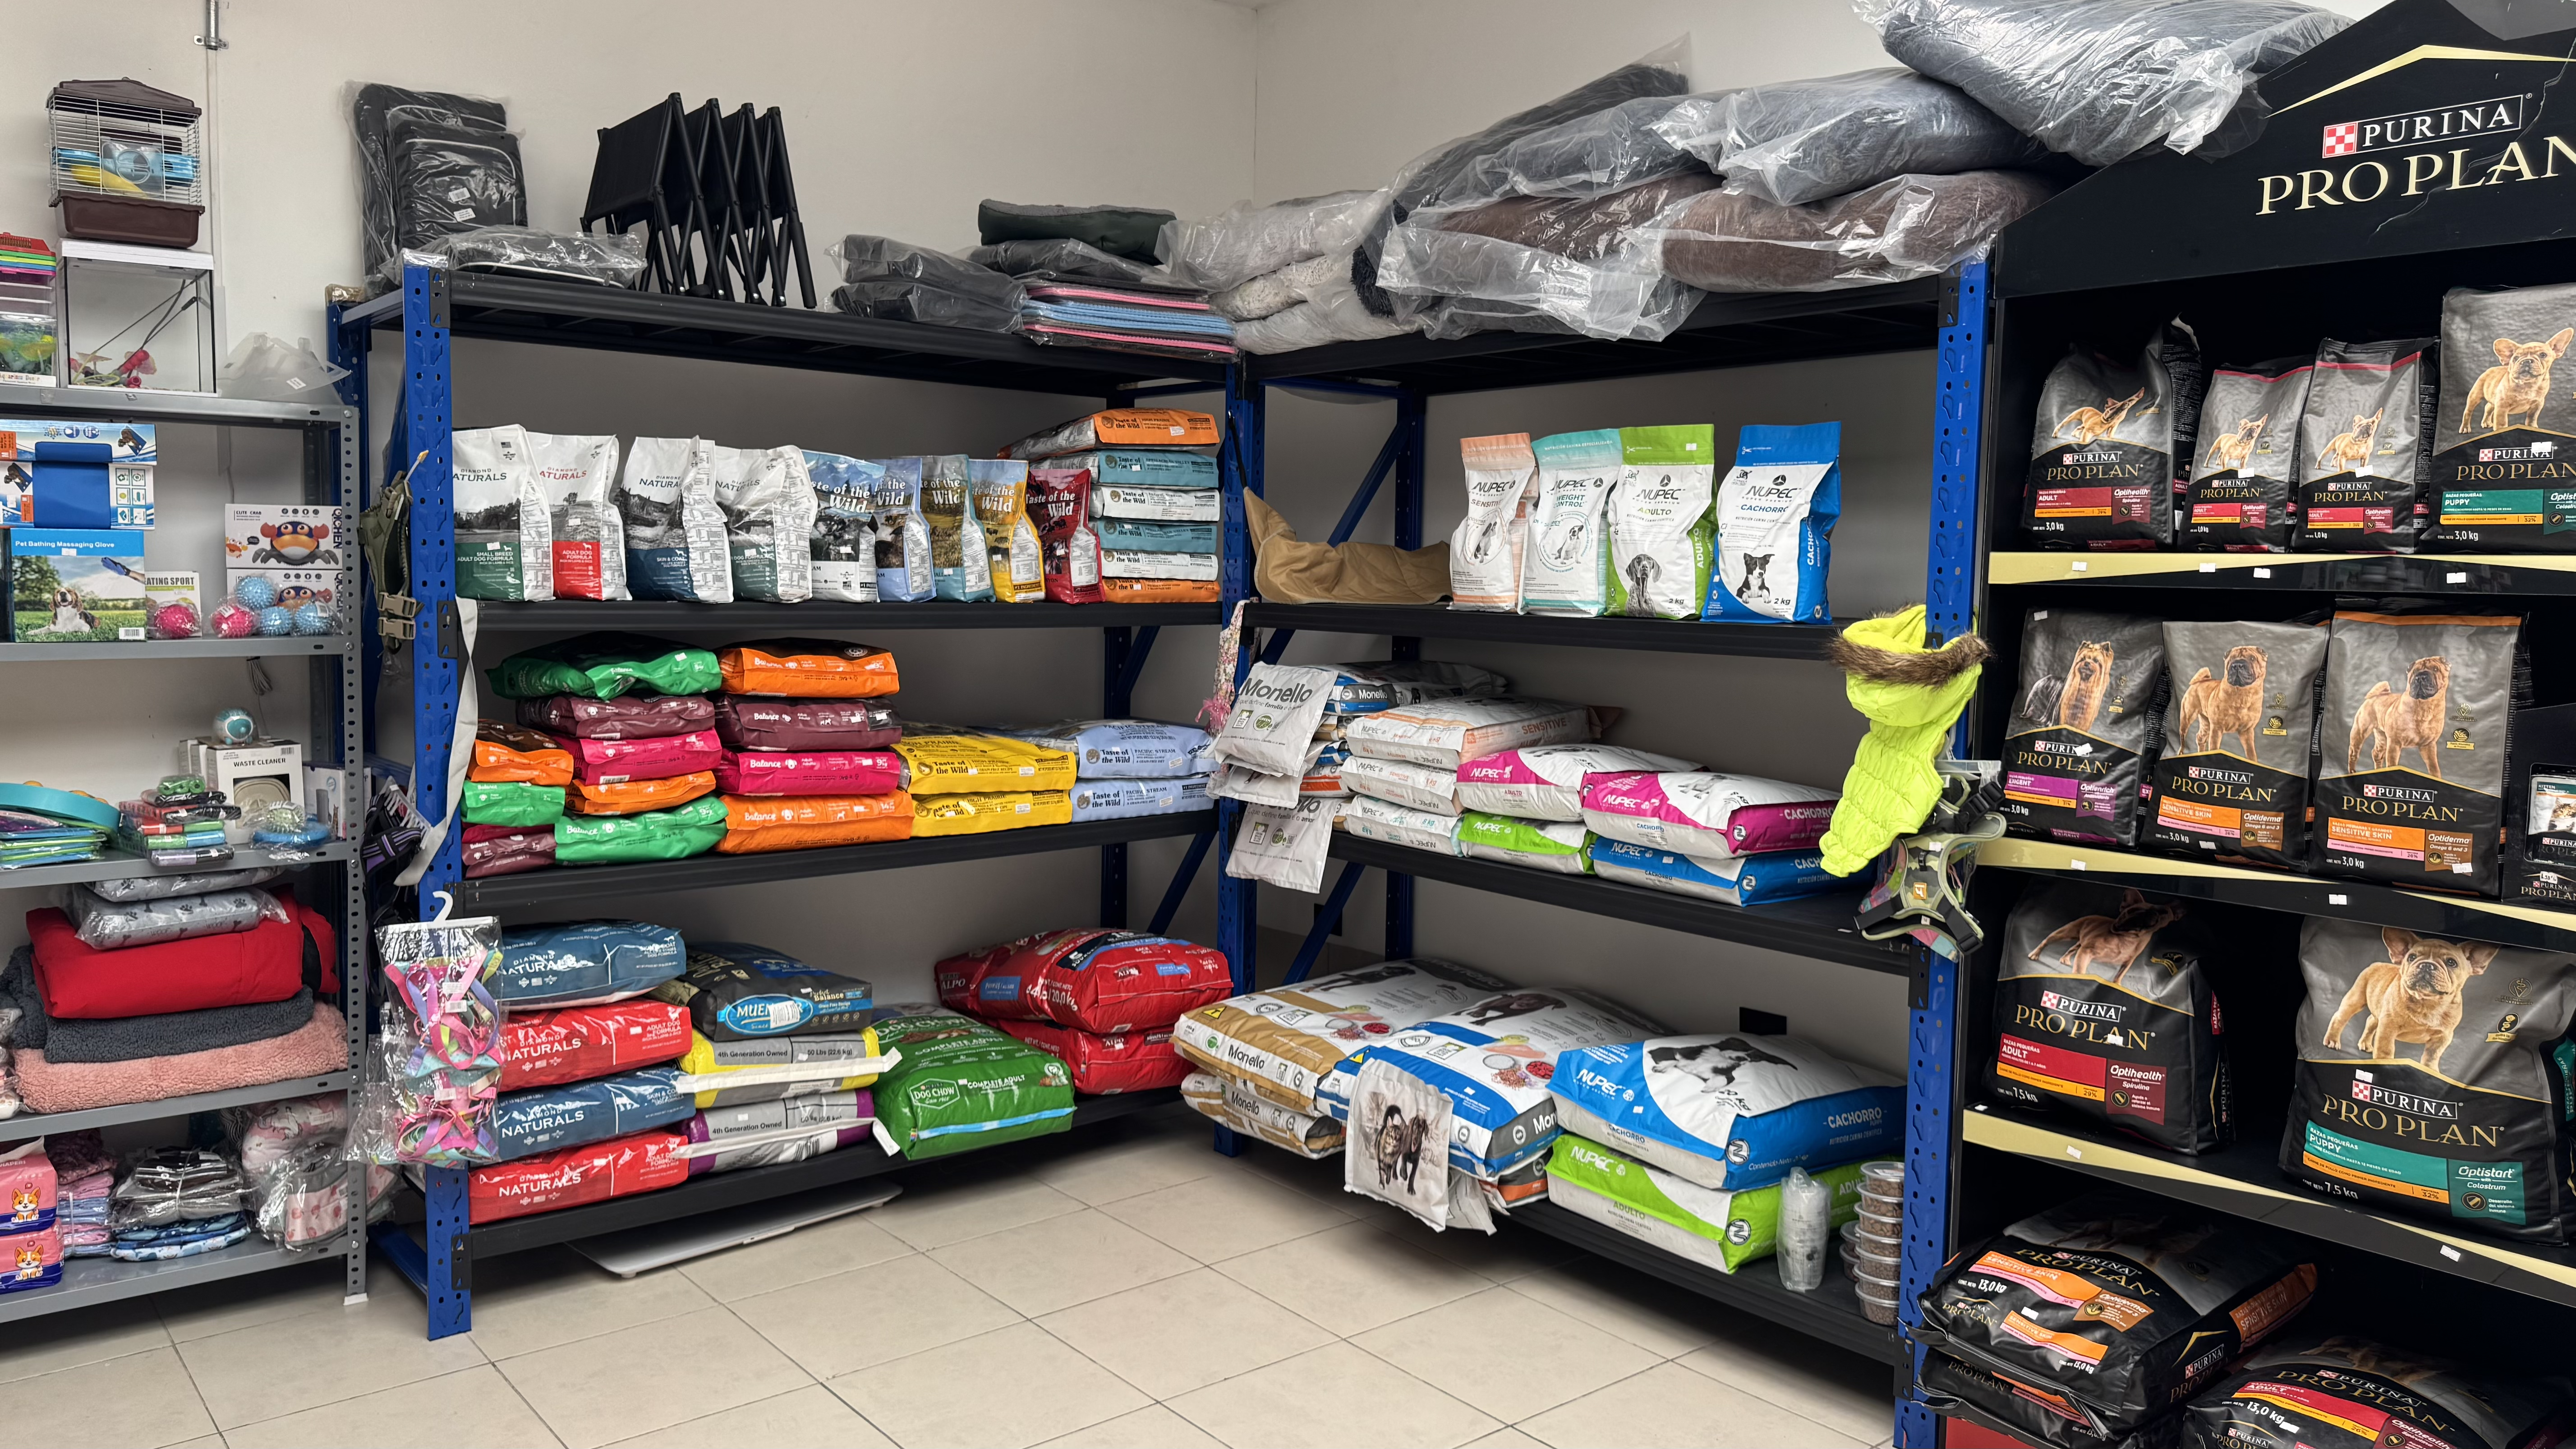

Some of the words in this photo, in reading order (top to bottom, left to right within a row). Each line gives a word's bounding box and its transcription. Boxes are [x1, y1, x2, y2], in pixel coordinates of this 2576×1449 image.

[2362, 103, 2512, 147] PURINA
[2255, 161, 2389, 216] PRO
[2074, 453, 2116, 462] PURINA
[2047, 466, 2081, 481] PRO
[2084, 464, 2139, 479] PLAN
[2456, 464, 2504, 480] PRO
[888, 478, 906, 490] the
[930, 478, 940, 488] of
[943, 477, 960, 488] the
[1472, 482, 1509, 492] NUPEC
[834, 484, 846, 494] of
[851, 486, 869, 499] the
[932, 489, 960, 505] Wild
[985, 485, 993, 495] of
[997, 485, 1014, 497] the
[1049, 492, 1058, 502] of
[1060, 491, 1075, 501] the
[1638, 488, 1683, 501] NUPEC
[1745, 486, 1797, 499] NUPEC
[2201, 488, 2224, 498] PRO
[2226, 488, 2260, 497] PLAN
[2314, 492, 2342, 502] PRO
[2345, 491, 2385, 501] PLAN
[830, 494, 867, 513] Wild
[982, 497, 1013, 512] Wild
[1048, 502, 1074, 518] Wild
[2046, 522, 2055, 531] 3,0
[2056, 522, 2064, 531] kg
[2454, 530, 2467, 541] 3,0
[2469, 531, 2479, 541] kg
[1694, 528, 1704, 569] ADULTO
[170, 577, 194, 586] SPORT
[1674, 598, 1684, 606] kg
[1779, 598, 1791, 606] kg
[1240, 678, 1313, 703] Monello
[1359, 689, 1388, 699] Monello
[1522, 718, 1567, 735] SENSITIVE
[257, 758, 286, 766] CLEANER
[750, 759, 782, 768] Balance
[2017, 751, 2052, 769] PRO
[2055, 755, 2107, 775] PLAN
[952, 766, 968, 774] Wild
[1470, 768, 1504, 778] NUPEC
[2199, 769, 2248, 783] PURINA
[2172, 776, 2210, 795] PRO
[2213, 784, 2273, 803] PLAN
[2378, 787, 2431, 801] PURINA
[1105, 799, 1121, 807] Wild
[1603, 794, 1642, 809] NUPEC
[2162, 803, 2194, 815] SENSITIVE
[2194, 810, 2212, 819] SKIN
[2341, 796, 2388, 815] PRO
[2392, 801, 2458, 822] PLAN
[745, 812, 776, 821] Balance
[2244, 813, 2282, 823] Optiderma
[566, 825, 598, 836] Balance
[1473, 821, 1504, 833] NUPEC
[2332, 826, 2370, 838] SENSITIVE
[2372, 830, 2392, 840] SKIN
[2428, 833, 2469, 844] Optiderma
[1611, 842, 1647, 856] NUPEC
[2342, 856, 2353, 868] 3,0
[2355, 858, 2364, 869] kg
[1645, 870, 1673, 880] CACHORRO
[2521, 886, 2547, 897] PRO
[2540, 882, 2568, 890] PURINA
[941, 979, 966, 990] ALPO
[814, 993, 844, 1002] Balance
[2058, 998, 2117, 1020] PURINA
[2014, 1004, 2066, 1034] PRO
[2068, 1019, 2150, 1051] PLAN
[842, 1048, 852, 1056] kg)
[1228, 1044, 1265, 1069] Monello
[2001, 1045, 2028, 1059] ADULT
[1003, 1074, 1025, 1083] ADULT
[2110, 1064, 2162, 1081] Optihealth
[1577, 1068, 1623, 1096] NUPEC
[2122, 1081, 2150, 1091] Spirulina
[914, 1088, 931, 1099] DOG
[932, 1086, 955, 1098] CHOW
[1231, 1091, 1259, 1115] Monello
[2372, 1088, 2453, 1118] PURINA
[501, 1110, 584, 1138] NATURALS
[1828, 1107, 1882, 1128] CACHORRO
[2321, 1093, 2387, 1131] PRO
[2394, 1114, 2499, 1148] PLAN
[724, 1124, 759, 1133] Generation
[760, 1121, 782, 1129] Owned
[1609, 1123, 1645, 1143] CACHORRO
[2310, 1127, 2326, 1139] RAZAS
[2309, 1134, 2341, 1153] PUPPY
[1570, 1145, 1615, 1172] NUPEC
[1748, 1159, 1778, 1171] Contenido
[2458, 1166, 2514, 1179] Optistart
[499, 1173, 582, 1197] NATURALS
[2467, 1181, 2506, 1192] Colostrum
[1613, 1201, 1646, 1219] ADULTO
[2194, 1348, 2222, 1372] PURINA
[2246, 1384, 2287, 1393] ADULT
[2339, 1374, 2419, 1407] PURINA
[2273, 1371, 2347, 1390] PRO
[2350, 1388, 2446, 1432] PLAN
[2247, 1400, 2269, 1417] 13,0
[2269, 1409, 2285, 1424] kg
